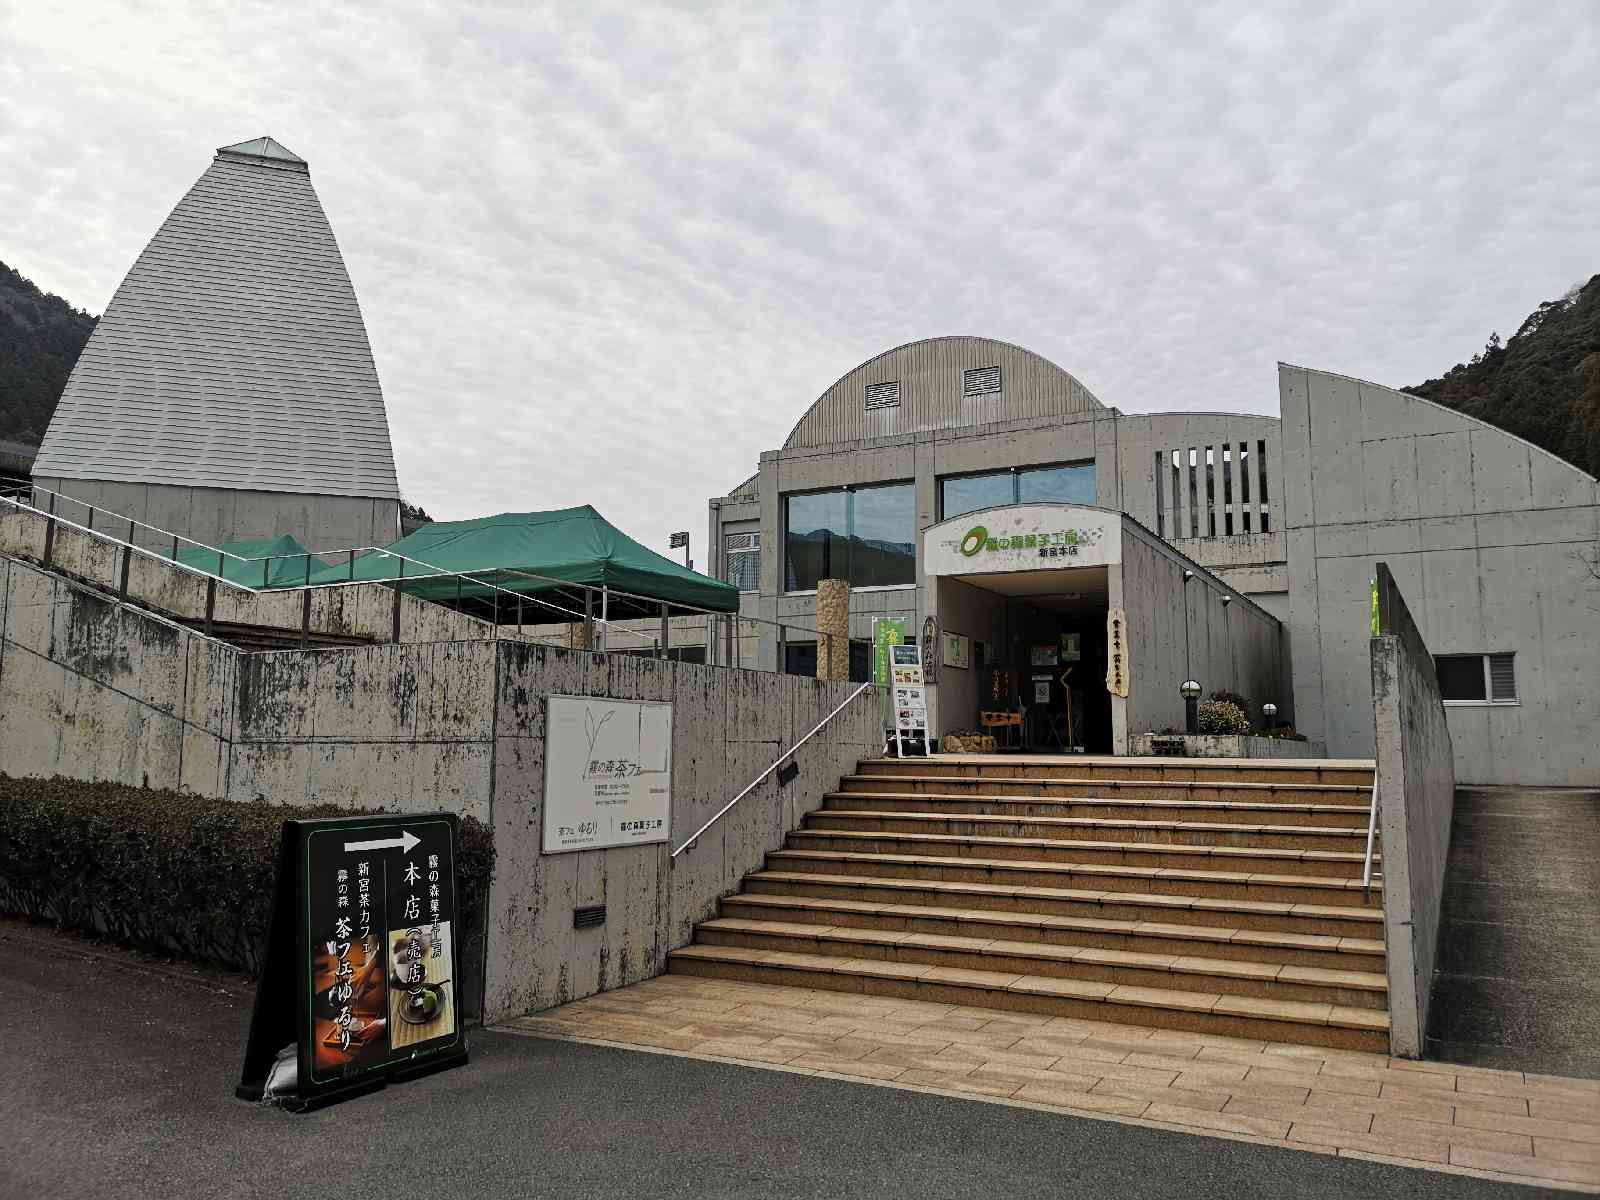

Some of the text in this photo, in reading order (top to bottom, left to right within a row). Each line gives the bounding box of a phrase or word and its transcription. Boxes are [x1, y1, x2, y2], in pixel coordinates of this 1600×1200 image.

[358, 861, 370, 953] 新宮茶カフェ
